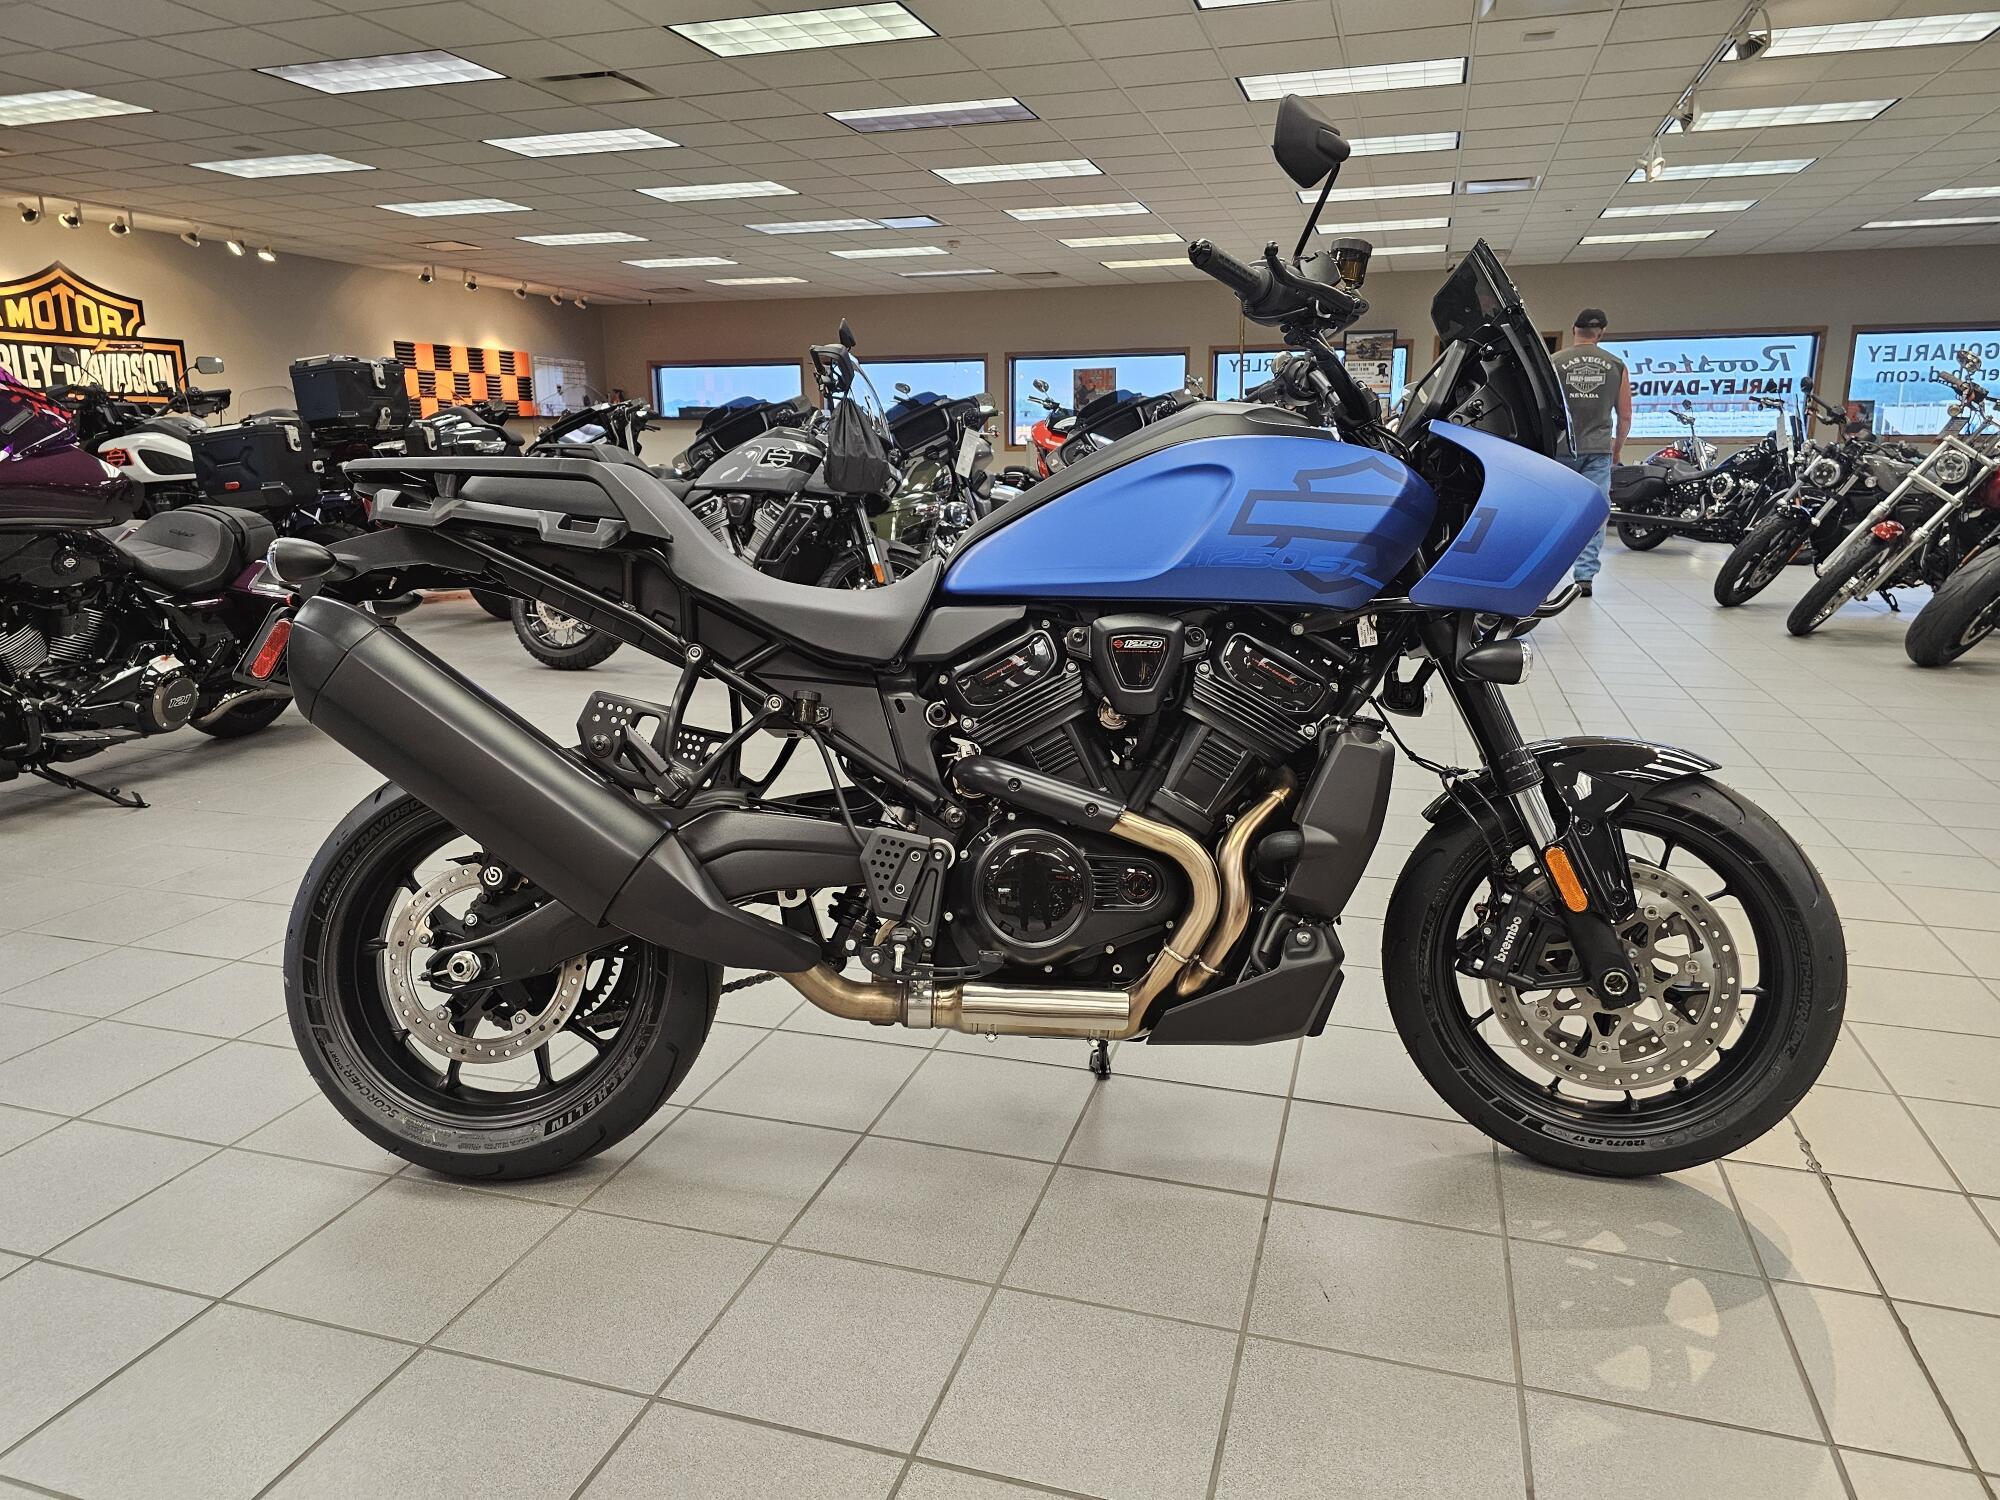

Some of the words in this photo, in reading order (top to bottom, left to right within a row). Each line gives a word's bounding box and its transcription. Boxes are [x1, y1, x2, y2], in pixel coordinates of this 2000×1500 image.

[5, 283, 124, 337] MOTOR
[0, 343, 178, 394] RLEY-DAVIDSON
[1561, 357, 1580, 370] LAS
[1581, 356, 1612, 370] VEGAS
[1124, 639, 1163, 649] 1250
[168, 693, 192, 708] 121
[317, 798, 423, 904] HARLEY-DAVIDSO
[1493, 916, 1522, 963] brembo
[342, 1067, 400, 1120] SCORCHER
